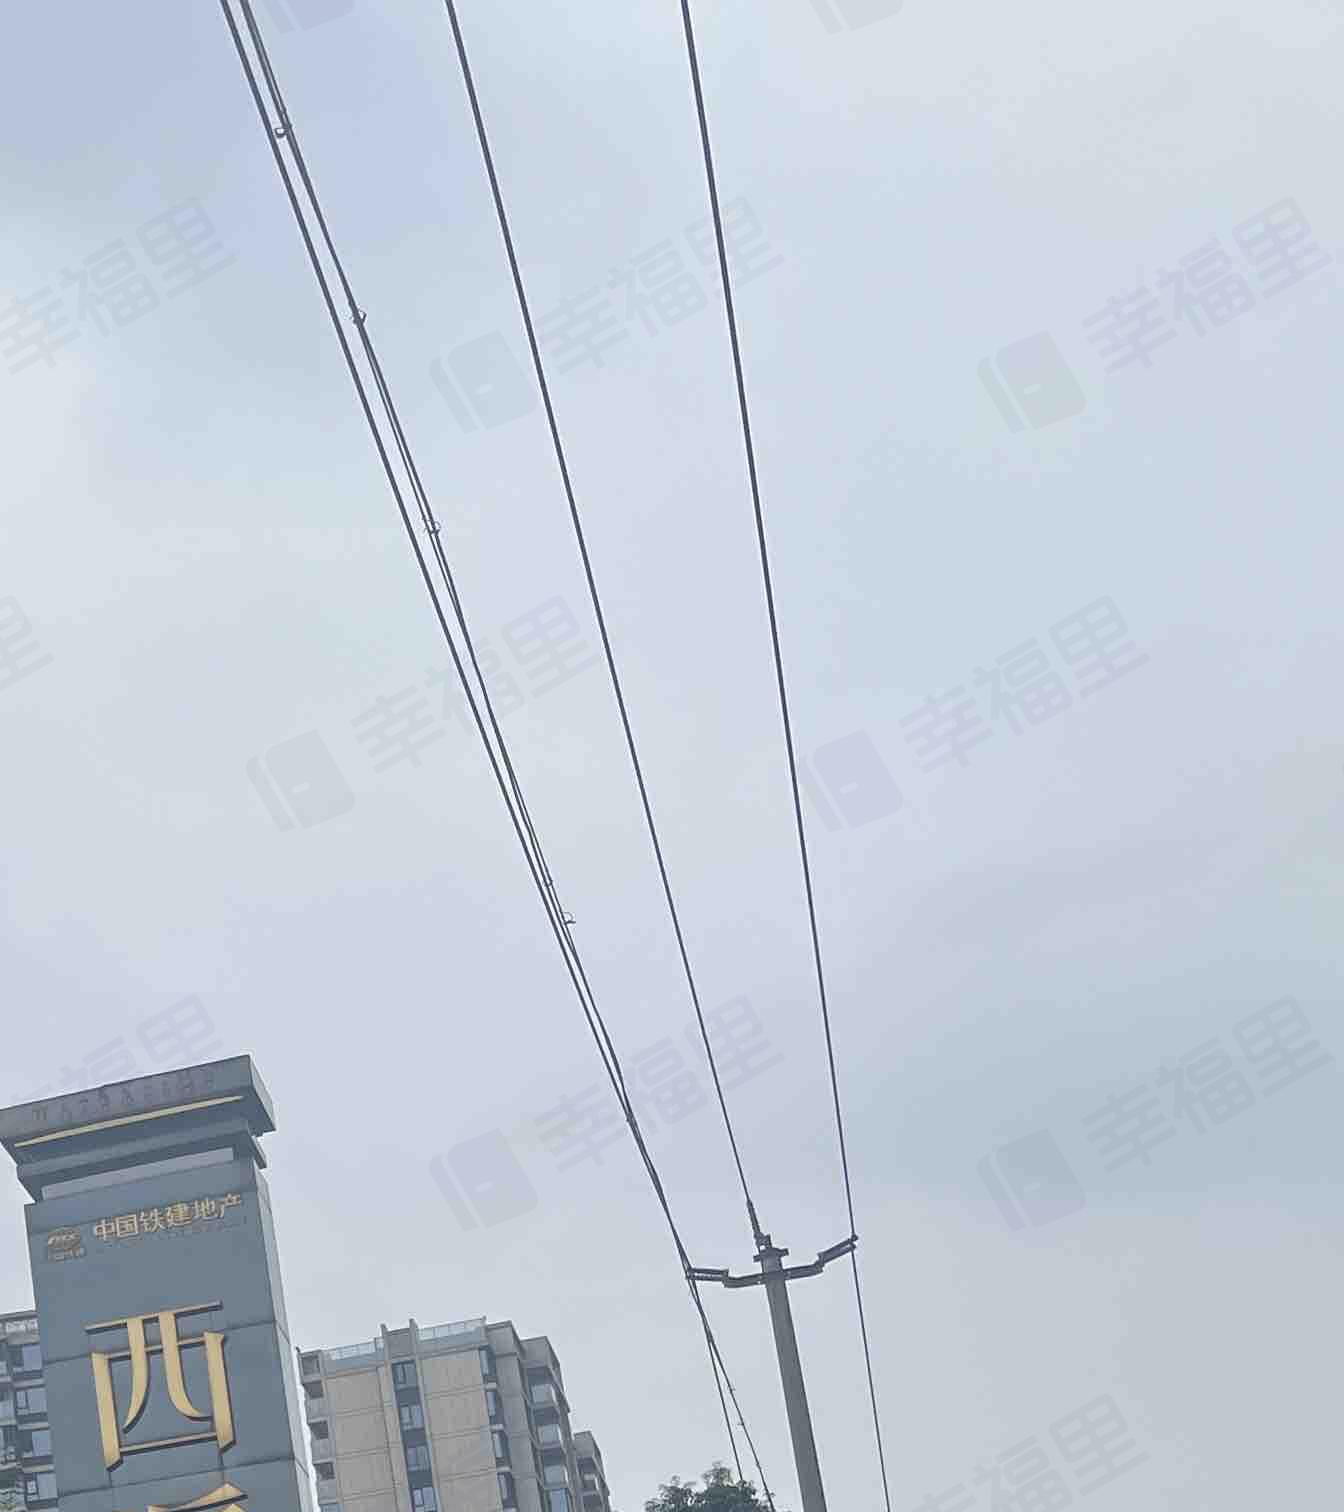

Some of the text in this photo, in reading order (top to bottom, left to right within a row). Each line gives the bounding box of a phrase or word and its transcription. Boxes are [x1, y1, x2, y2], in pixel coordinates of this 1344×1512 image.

[92, 1192, 242, 1242] 中国铁建地产
